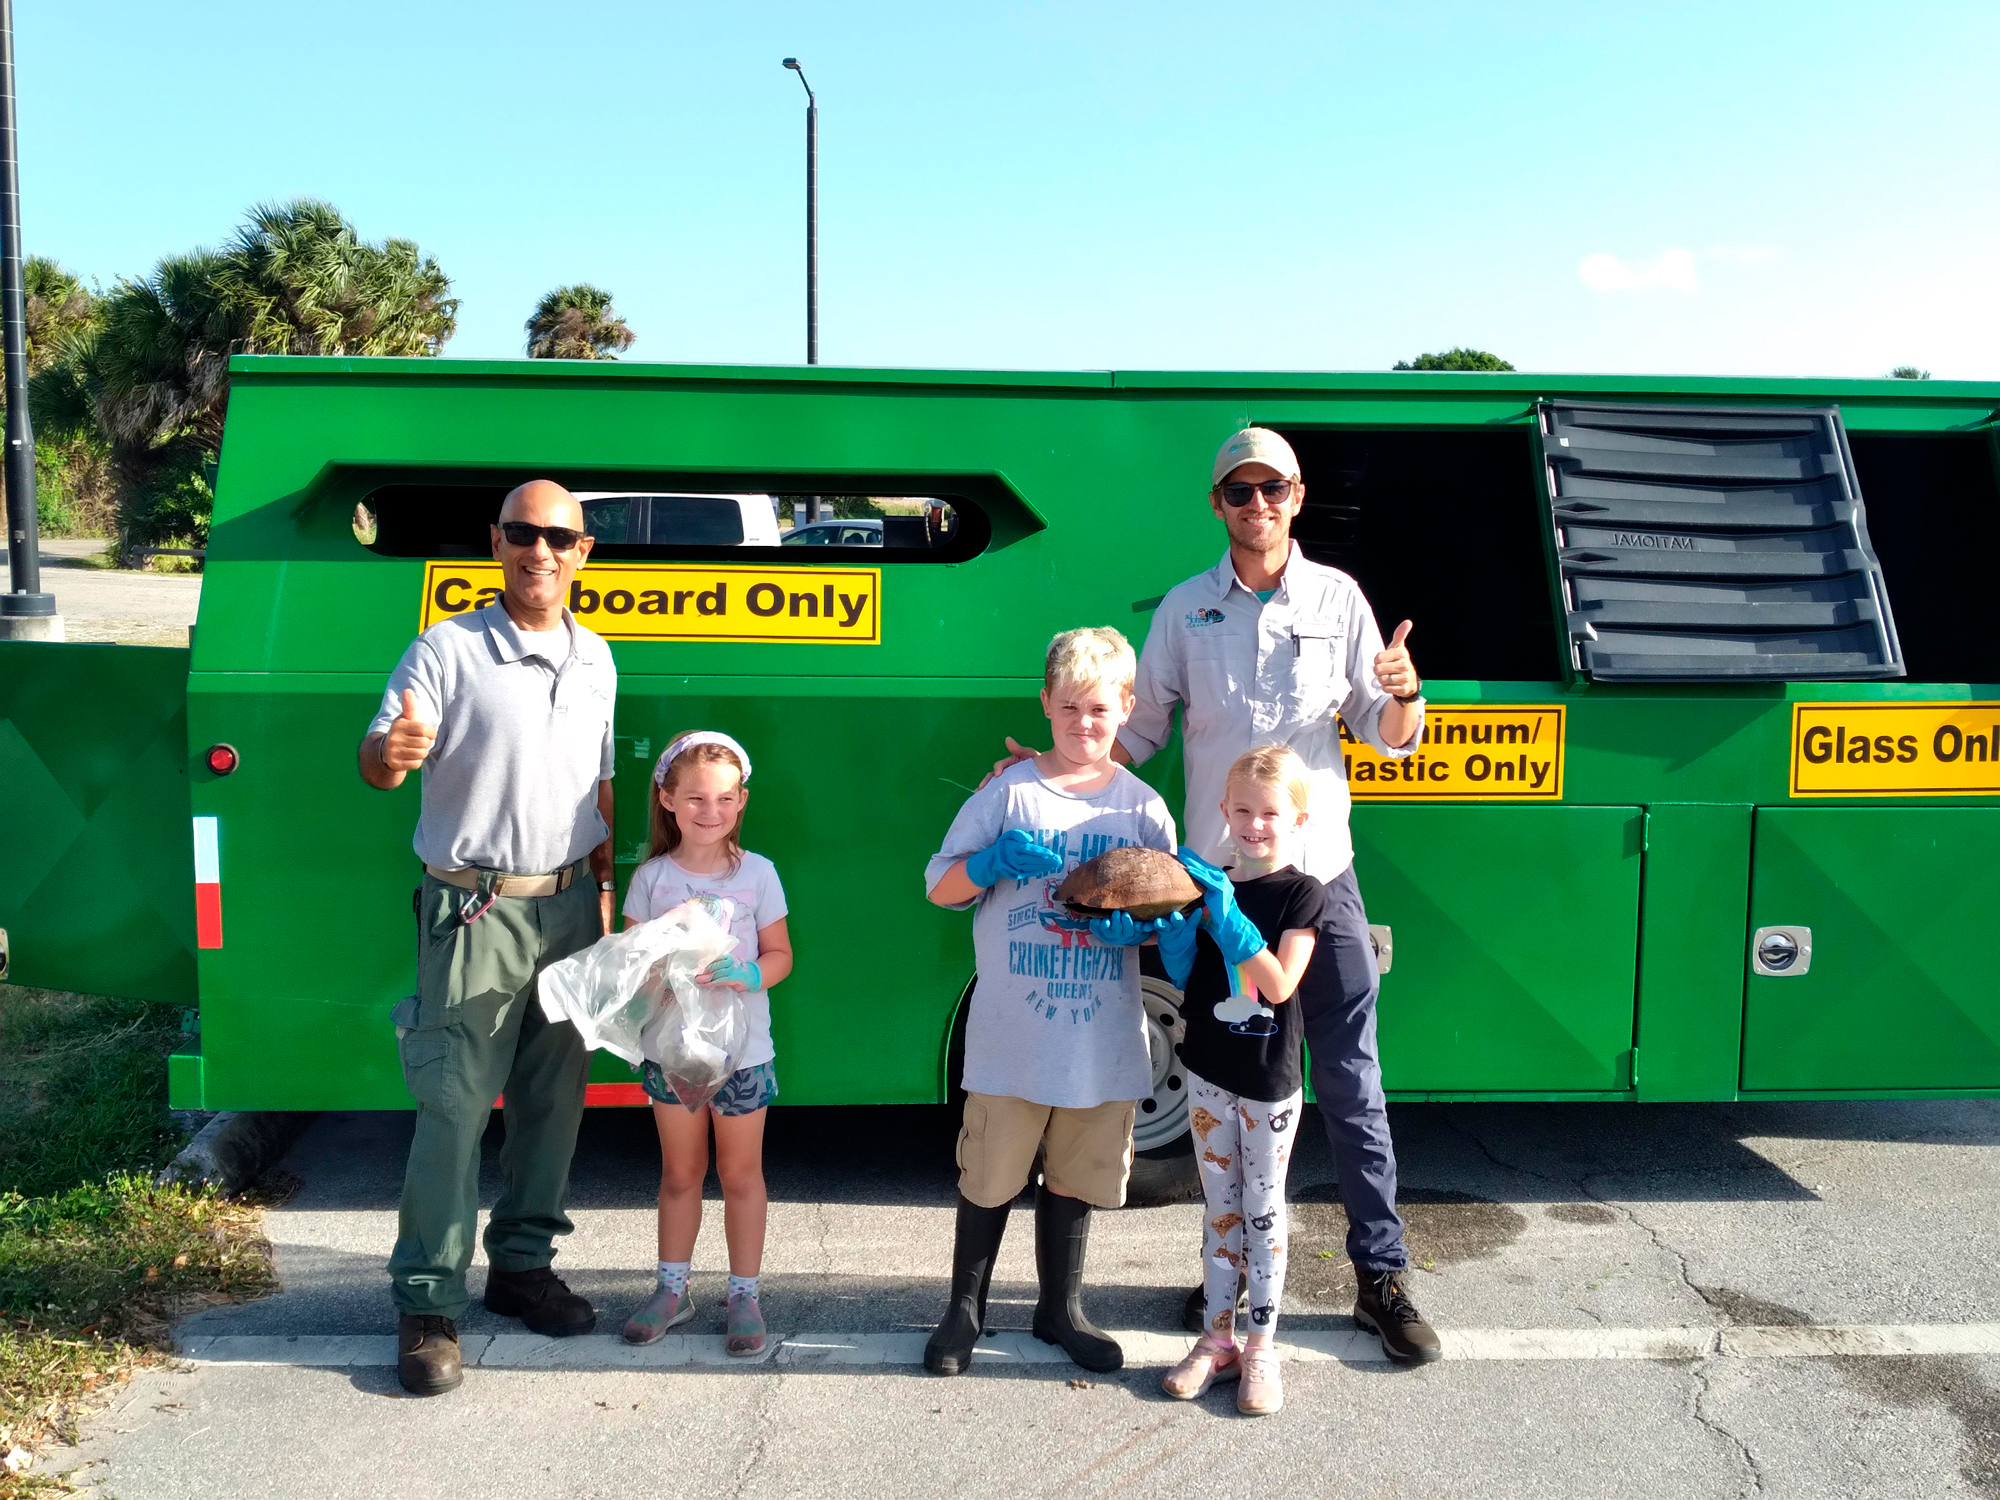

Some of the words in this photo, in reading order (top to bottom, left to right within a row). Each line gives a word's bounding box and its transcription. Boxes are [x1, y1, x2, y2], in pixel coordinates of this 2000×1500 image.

[435, 578, 727, 616] Caboard
[746, 582, 869, 628] Only
[1337, 717, 1543, 744] Ainum/
[1803, 725, 1919, 764] Glass
[1933, 724, 2000, 763] Onl
[1344, 755, 1450, 782] lastic
[1464, 754, 1552, 789] Only
[1007, 905, 1037, 928] SINCE
[1009, 941, 1124, 981] CRIMEFIGHTER
[1025, 990, 1058, 1021] NEW
[1071, 994, 1102, 1025] YORK
[1046, 982, 1093, 1000] QUEENS
